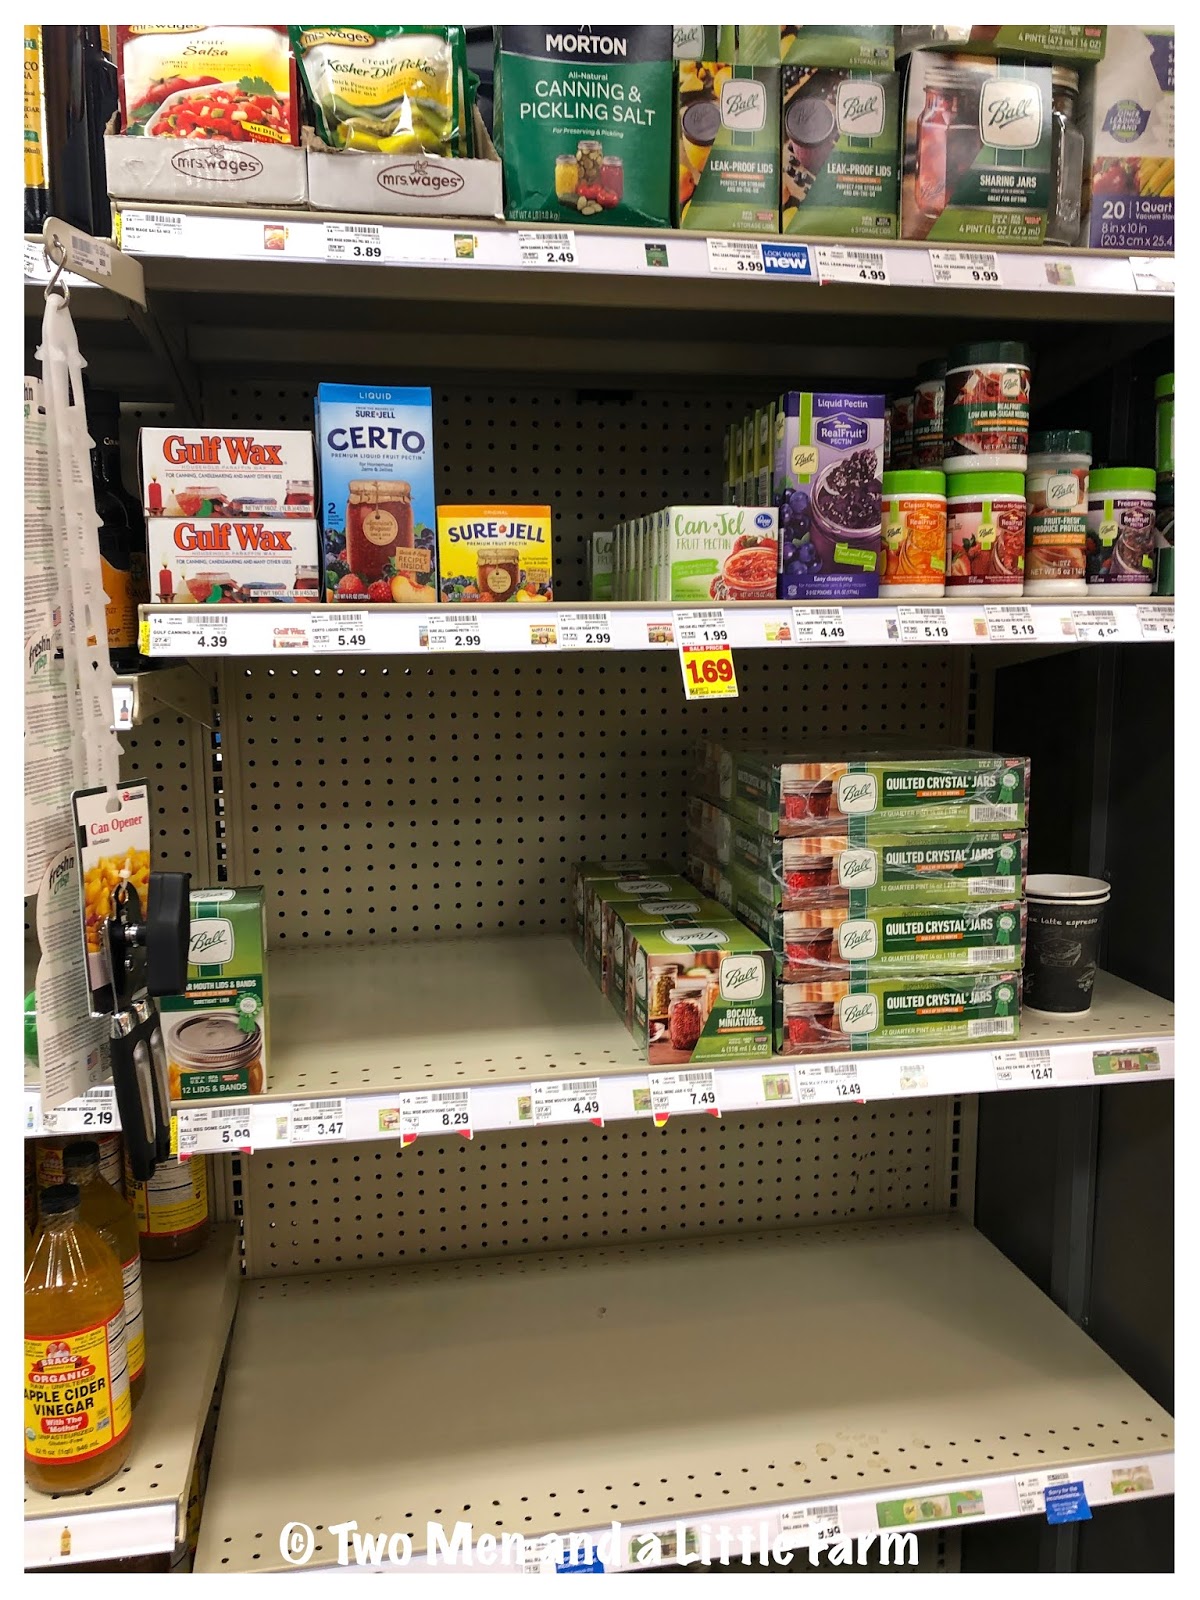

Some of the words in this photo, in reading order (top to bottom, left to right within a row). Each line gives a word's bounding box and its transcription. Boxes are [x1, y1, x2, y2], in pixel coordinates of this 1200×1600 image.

[182, 45, 229, 57] Salsa
[545, 34, 627, 56] MORTON
[328, 59, 371, 77] Kosher
[568, 71, 608, 80] All-Natural
[535, 80, 624, 101] CANNING
[628, 86, 642, 103] &
[726, 94, 759, 117] Ball
[843, 96, 878, 121] Ball
[520, 102, 608, 120] PICKLING
[612, 106, 656, 126] SALT
[988, 98, 1033, 129] Ball
[250, 125, 283, 140] MEDIUM
[563, 127, 596, 136] Preserving
[601, 130, 624, 139] Pickling
[710, 160, 756, 172] LEAK-PROOF
[757, 162, 773, 173] LIDS
[827, 163, 873, 176] LEAK-PROOF
[875, 165, 892, 177] LIDS
[980, 174, 1015, 187] SHARING
[1016, 176, 1037, 188] JARS
[1102, 200, 1125, 219] 20
[1141, 201, 1172, 213] Quart
[1101, 222, 1108, 234] 8
[1128, 223, 1137, 234] 10
[1101, 234, 1125, 247] (20.3
[1127, 237, 1144, 246] cm
[353, 246, 382, 257] 3.89
[546, 252, 574, 263] 2.49
[737, 261, 763, 271] 3.99
[765, 256, 807, 269] new
[859, 269, 886, 281] 4.99
[972, 270, 998, 281] 9.99
[359, 391, 391, 401] LIQUID
[817, 398, 843, 409] Liquid
[844, 399, 868, 409] Pectin
[327, 426, 425, 453] CERTO
[820, 428, 862, 439] RealFruit
[163, 435, 221, 464] Gulf
[223, 437, 283, 465] Wax
[794, 453, 814, 466] Ball
[1051, 483, 1075, 500] Ball
[328, 502, 336, 514] 2
[1043, 517, 1080, 525] FRUIT-FRESH
[448, 522, 498, 543] SURE
[506, 522, 545, 543] JELL
[1033, 524, 1058, 533] PRODUCE
[174, 522, 231, 551] Gulf
[233, 523, 293, 551] Wax
[676, 538, 699, 550] FRUIT
[703, 538, 731, 550] PECTIN
[703, 630, 728, 641] 1.99
[820, 627, 844, 638] 4.49
[925, 627, 948, 638] 5.19
[1011, 625, 1035, 635] 5.19
[197, 636, 228, 647] 4.39
[338, 634, 366, 646] 5.49
[455, 635, 481, 646] 2.99
[585, 633, 611, 643] 2.99
[686, 658, 733, 684] 1.69
[842, 782, 872, 804] Ball
[886, 777, 925, 790] QUILTED
[927, 776, 969, 789] CRYSTAL
[972, 775, 996, 788] JARS
[91, 823, 109, 836] Can
[112, 815, 143, 832] Opener
[843, 857, 872, 878] Ball
[886, 851, 924, 864] QUILTED
[926, 850, 967, 863] CRYSTAL
[970, 848, 994, 860] JARS
[1041, 917, 1062, 925] latte
[1066, 917, 1098, 928] espresso
[843, 929, 873, 950] Ball
[885, 921, 924, 936] QUILTED
[927, 919, 967, 932] CRYSTAL
[970, 918, 993, 931] JARS
[190, 929, 227, 953] Ball
[725, 966, 758, 989] Ball
[193, 982, 215, 990] MOUTH
[215, 981, 229, 989] LIDS
[236, 980, 256, 988] BANDS
[726, 1007, 756, 1019] BOCAUX
[845, 1002, 873, 1023] Ball
[886, 995, 924, 1009] QUILTED
[927, 993, 967, 1007] CRYSTAL
[970, 991, 992, 1005] JARS
[719, 1016, 764, 1027] MINIATURES
[1031, 1068, 1053, 1080] 12.47
[219, 1083, 247, 1092] BANDS
[836, 1084, 861, 1096] 12.49
[690, 1092, 715, 1105] 7.49
[573, 1101, 599, 1114] 4.49
[83, 1112, 112, 1125] 2.19
[442, 1113, 469, 1125] 8.29
[318, 1122, 343, 1135] 3.47
[42, 1355, 78, 1367] BRAGG
[33, 1368, 90, 1383] ORGANIC
[24, 1389, 60, 1403] APPLE
[64, 1377, 106, 1401] CIDER
[34, 1397, 94, 1417] VINEGAR
[46, 1418, 64, 1426] With
[66, 1416, 82, 1424] The
[1048, 1488, 1061, 1496] Sorry
